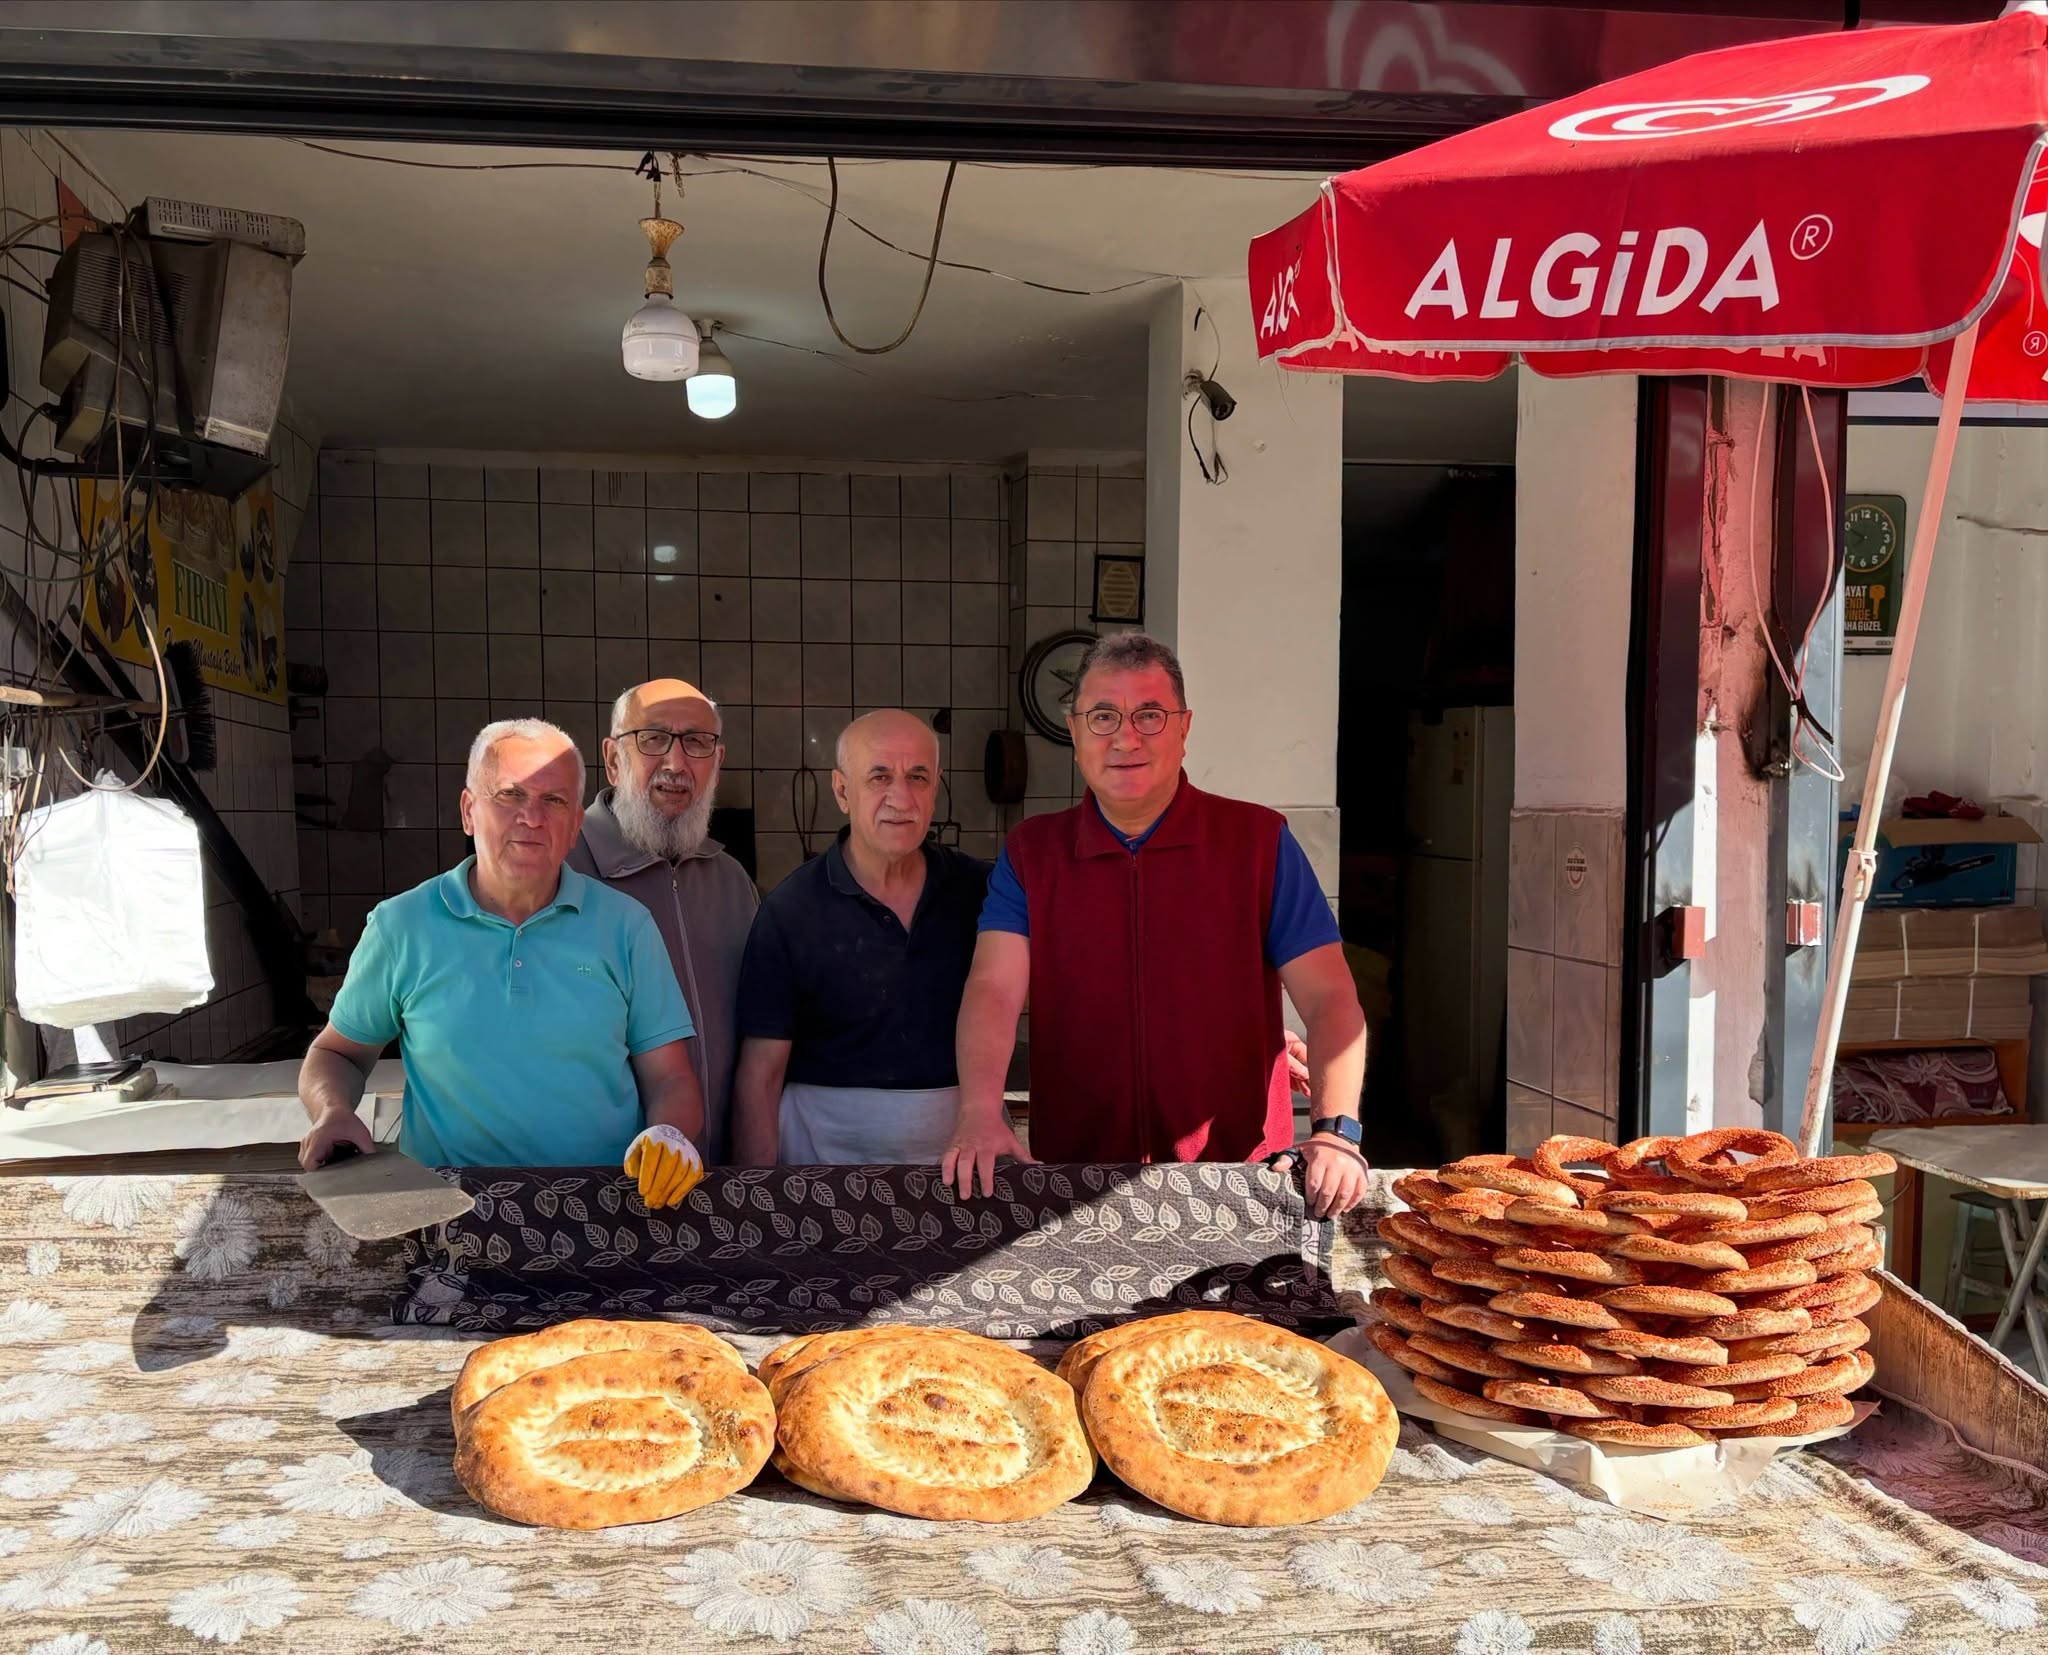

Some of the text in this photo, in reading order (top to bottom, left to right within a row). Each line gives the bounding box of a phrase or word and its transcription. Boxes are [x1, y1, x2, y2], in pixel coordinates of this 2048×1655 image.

[1404, 218, 1780, 320] ALGiDA
[1861, 509, 1871, 519] 12
[1845, 585, 1868, 597] AYAT
